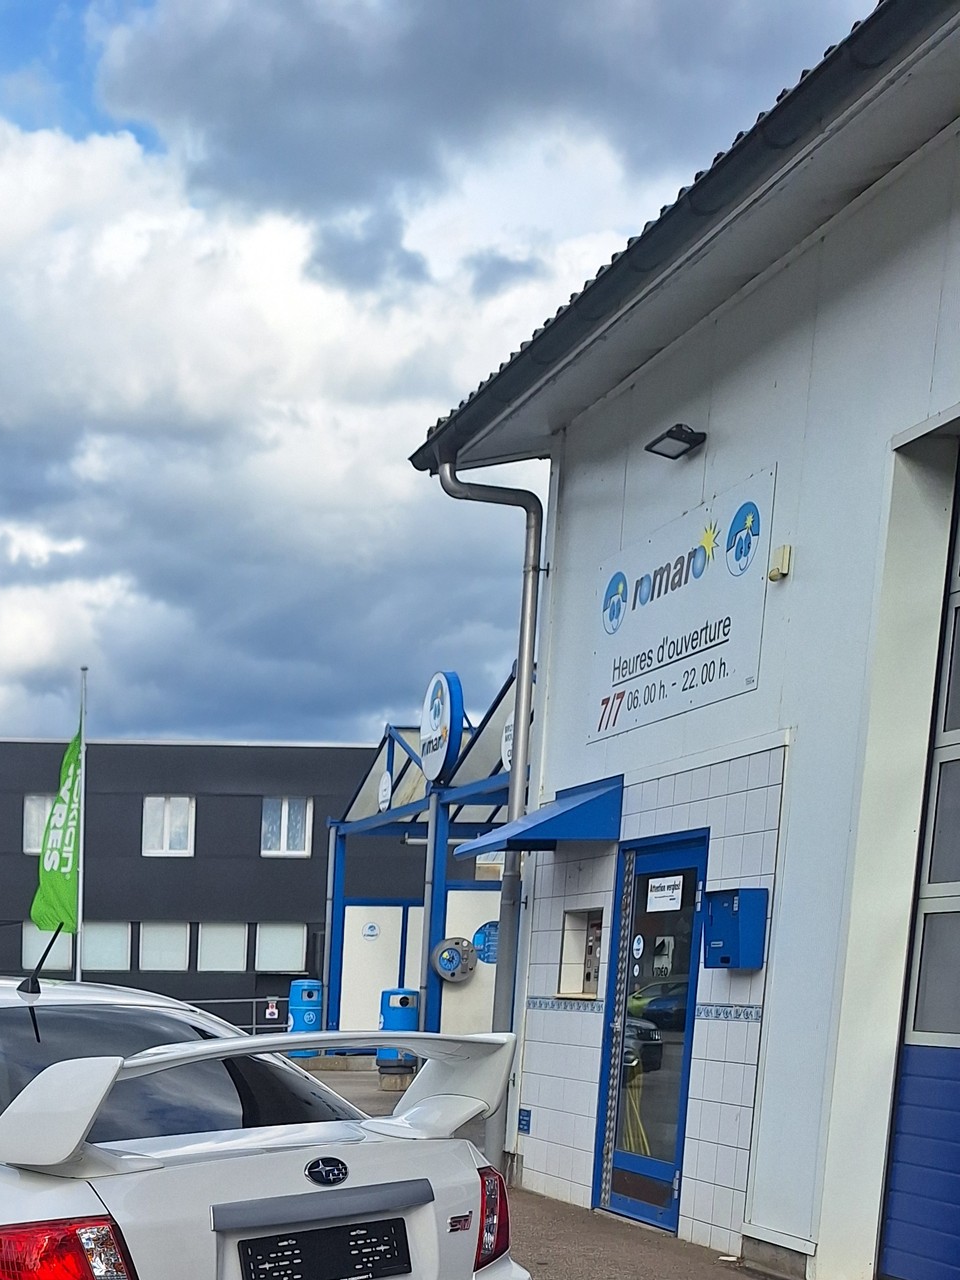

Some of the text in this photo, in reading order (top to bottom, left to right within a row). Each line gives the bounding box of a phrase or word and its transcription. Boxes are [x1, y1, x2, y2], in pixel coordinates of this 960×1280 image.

[632, 545, 706, 610] romaro
[611, 615, 732, 682] Heures d'ouverture
[597, 690, 626, 732] 7/7
